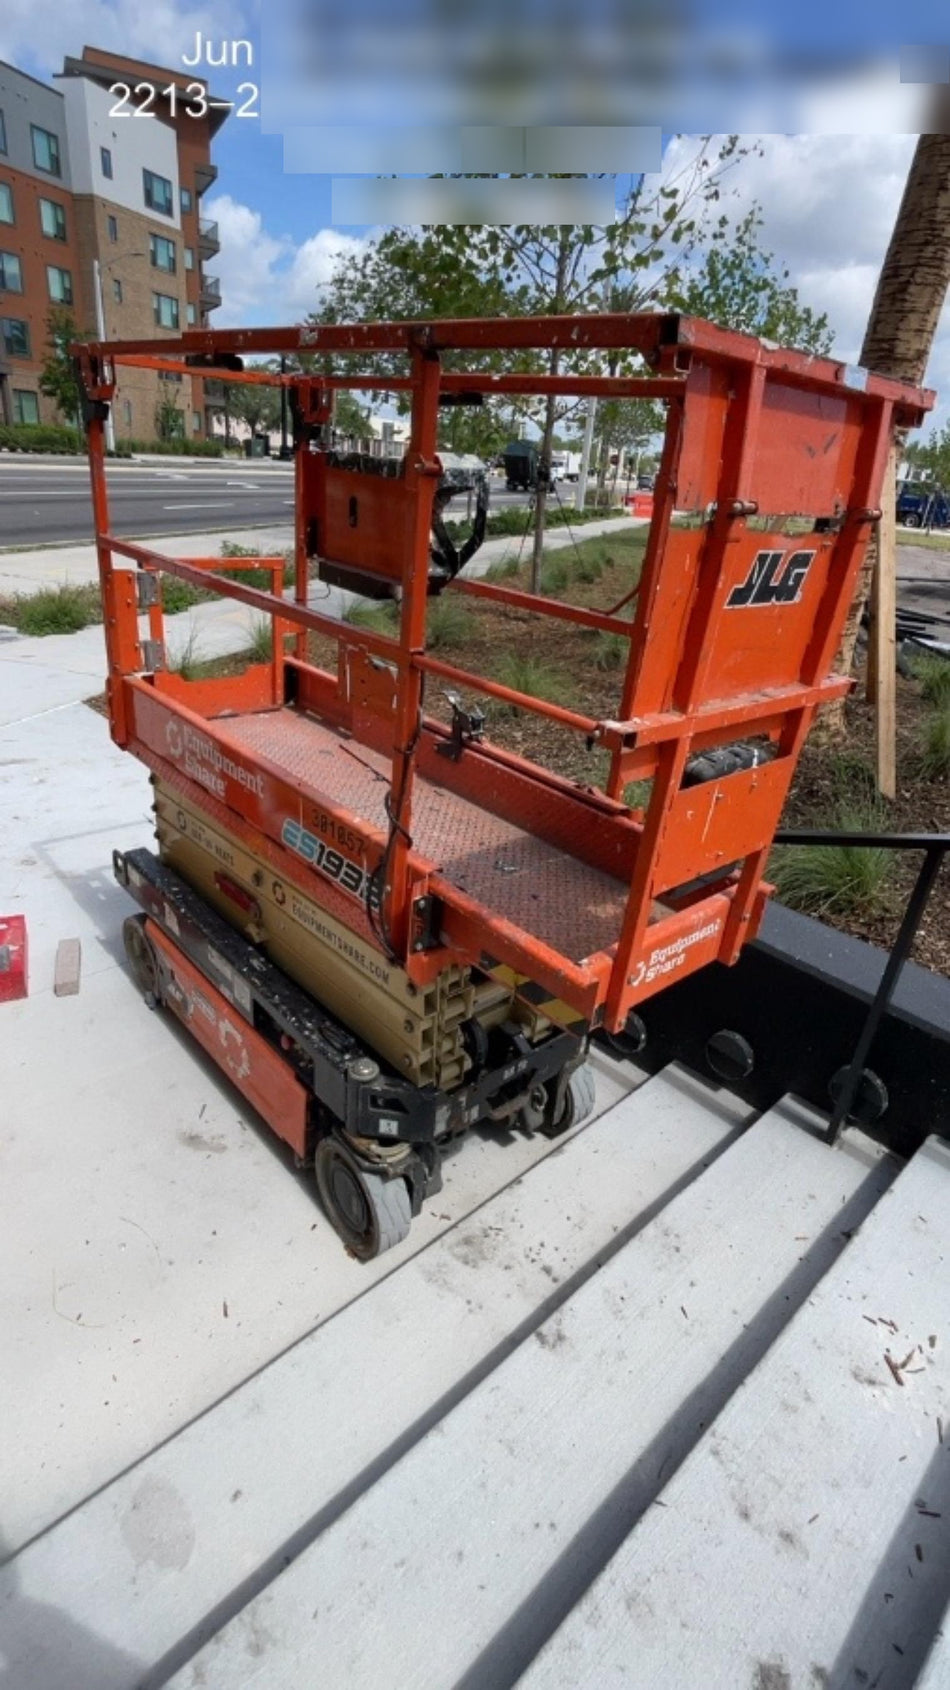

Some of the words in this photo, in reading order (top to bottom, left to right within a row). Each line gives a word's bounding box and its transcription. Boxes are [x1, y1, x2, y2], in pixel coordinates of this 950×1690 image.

[723, 550, 817, 609] JLG
[183, 724, 264, 799] Equipment
[185, 751, 226, 798] Share
[649, 918, 721, 966] Equipment
[645, 953, 687, 983] Share
